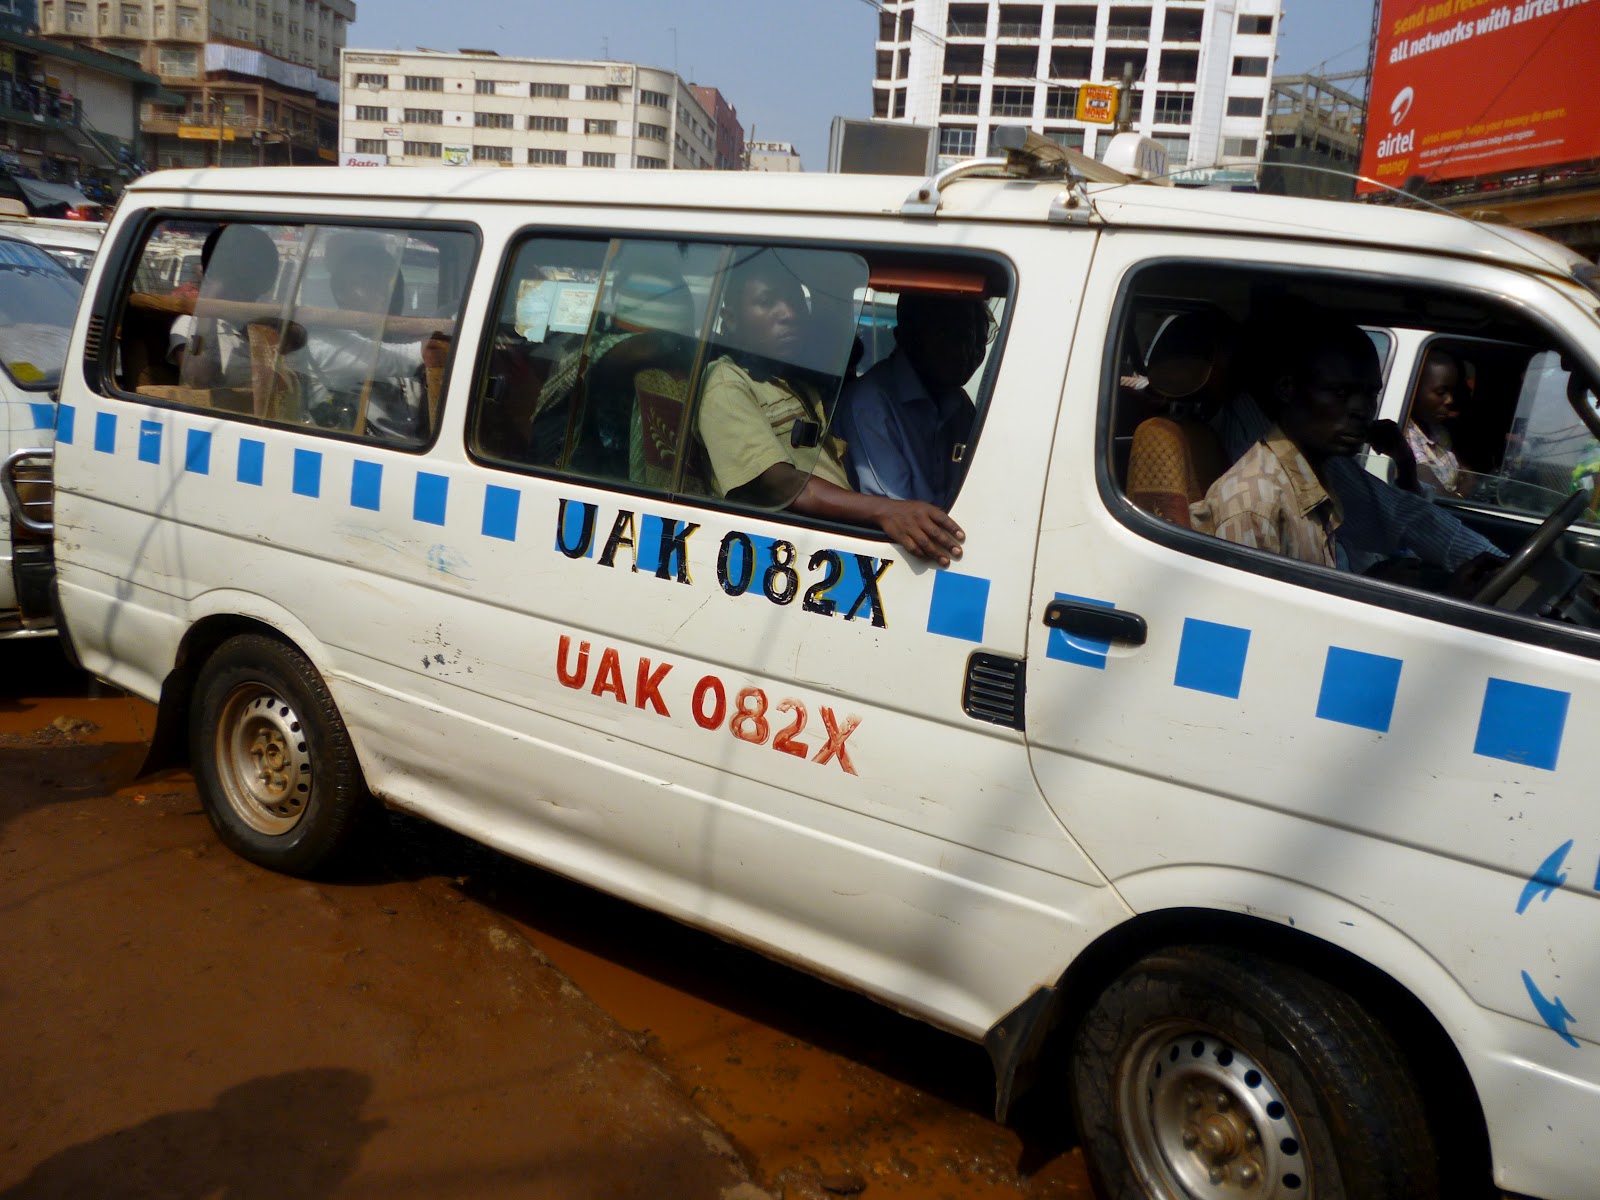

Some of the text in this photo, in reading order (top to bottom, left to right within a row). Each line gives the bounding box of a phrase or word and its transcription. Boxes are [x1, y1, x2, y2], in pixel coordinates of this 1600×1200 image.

[1389, 0, 1560, 64] all networks with airtel
[1393, 5, 1426, 36] send
[1426, 0, 1453, 24] and
[1086, 88, 1112, 100] MOBILE
[1085, 107, 1110, 119] MONEY
[744, 142, 787, 152] OTEL
[1377, 128, 1415, 158] airtel
[346, 158, 379, 167] Bata
[1139, 143, 1167, 176] TAXI
[1376, 158, 1409, 176] money
[558, 498, 894, 629] UAK 082X
[556, 634, 863, 776] UAK 082X
